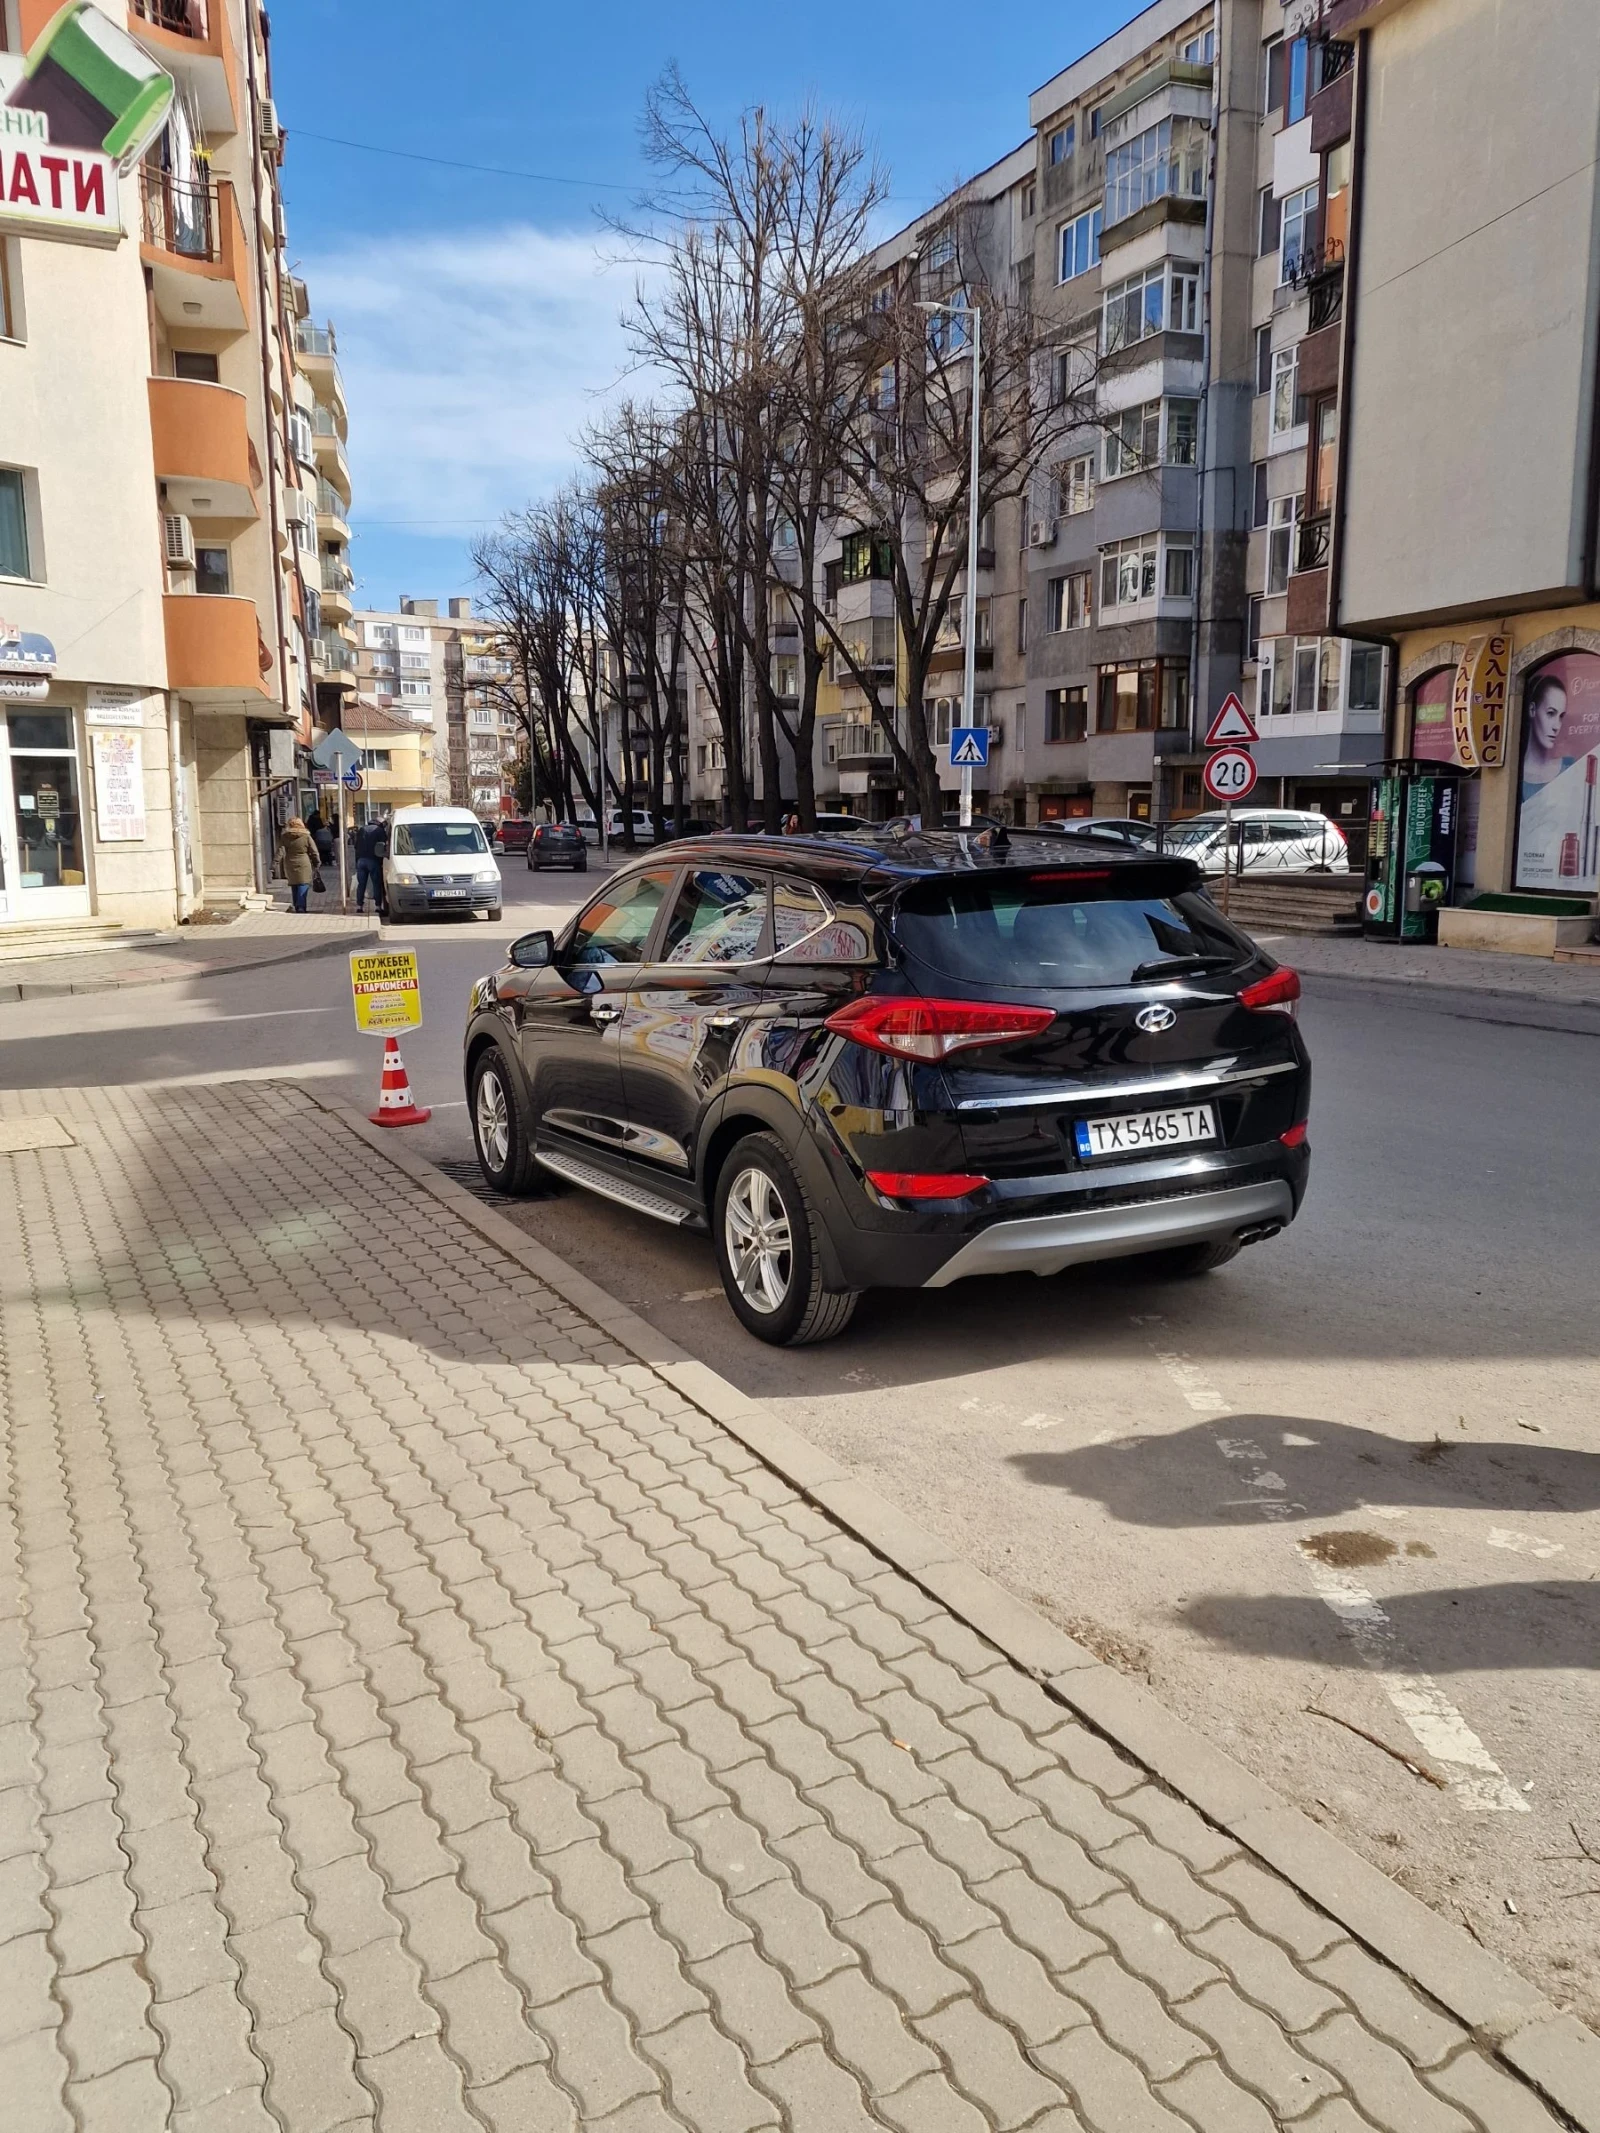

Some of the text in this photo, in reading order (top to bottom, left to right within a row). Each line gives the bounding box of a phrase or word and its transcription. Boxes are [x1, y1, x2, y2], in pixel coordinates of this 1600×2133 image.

[1216, 761, 1246, 787] 20
[1416, 787, 1428, 836] BIO COFFEE
[1438, 787, 1452, 835] LAVAZZA
[357, 955, 410, 969] СЛУЖЕБЕН
[357, 967, 413, 982] АБОНАМЕНТ
[357, 980, 416, 993] 2 ПАРКОМЕСТА
